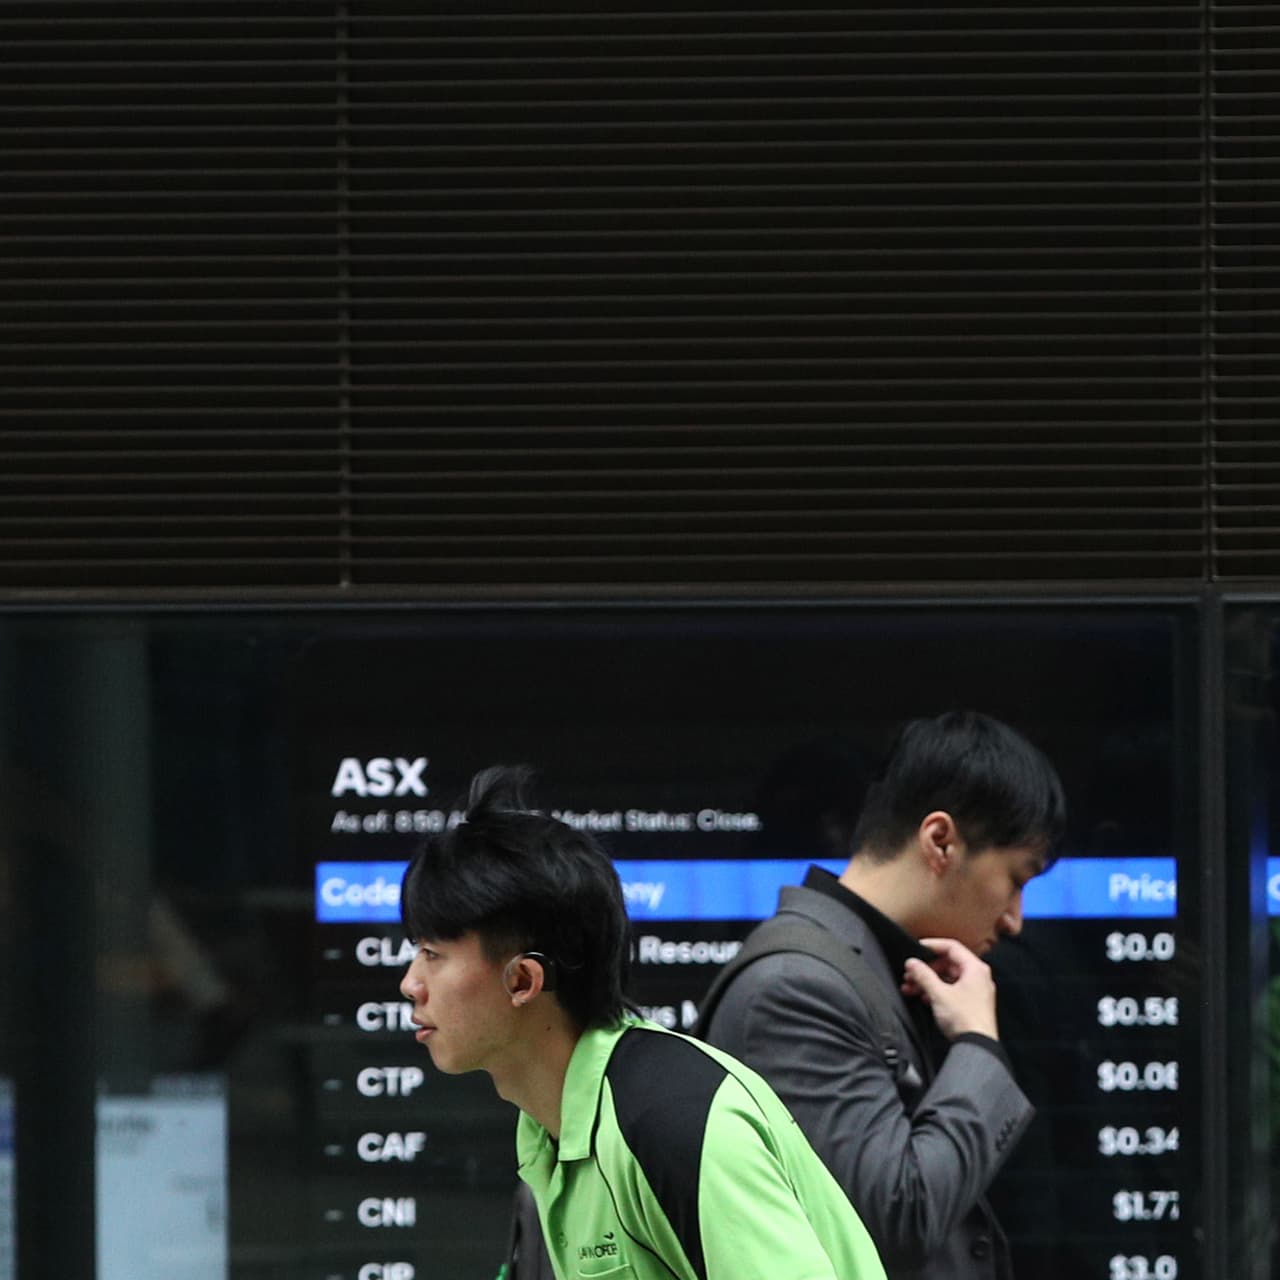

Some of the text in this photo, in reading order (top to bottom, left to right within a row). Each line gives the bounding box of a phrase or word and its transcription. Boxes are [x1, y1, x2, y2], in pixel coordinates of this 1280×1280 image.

[331, 757, 428, 797] ASX
[331, 810, 360, 833] As
[320, 877, 401, 907] Code
[356, 1067, 423, 1097] CTP
[357, 1133, 426, 1162] CAF
[358, 1198, 417, 1228] CNI
